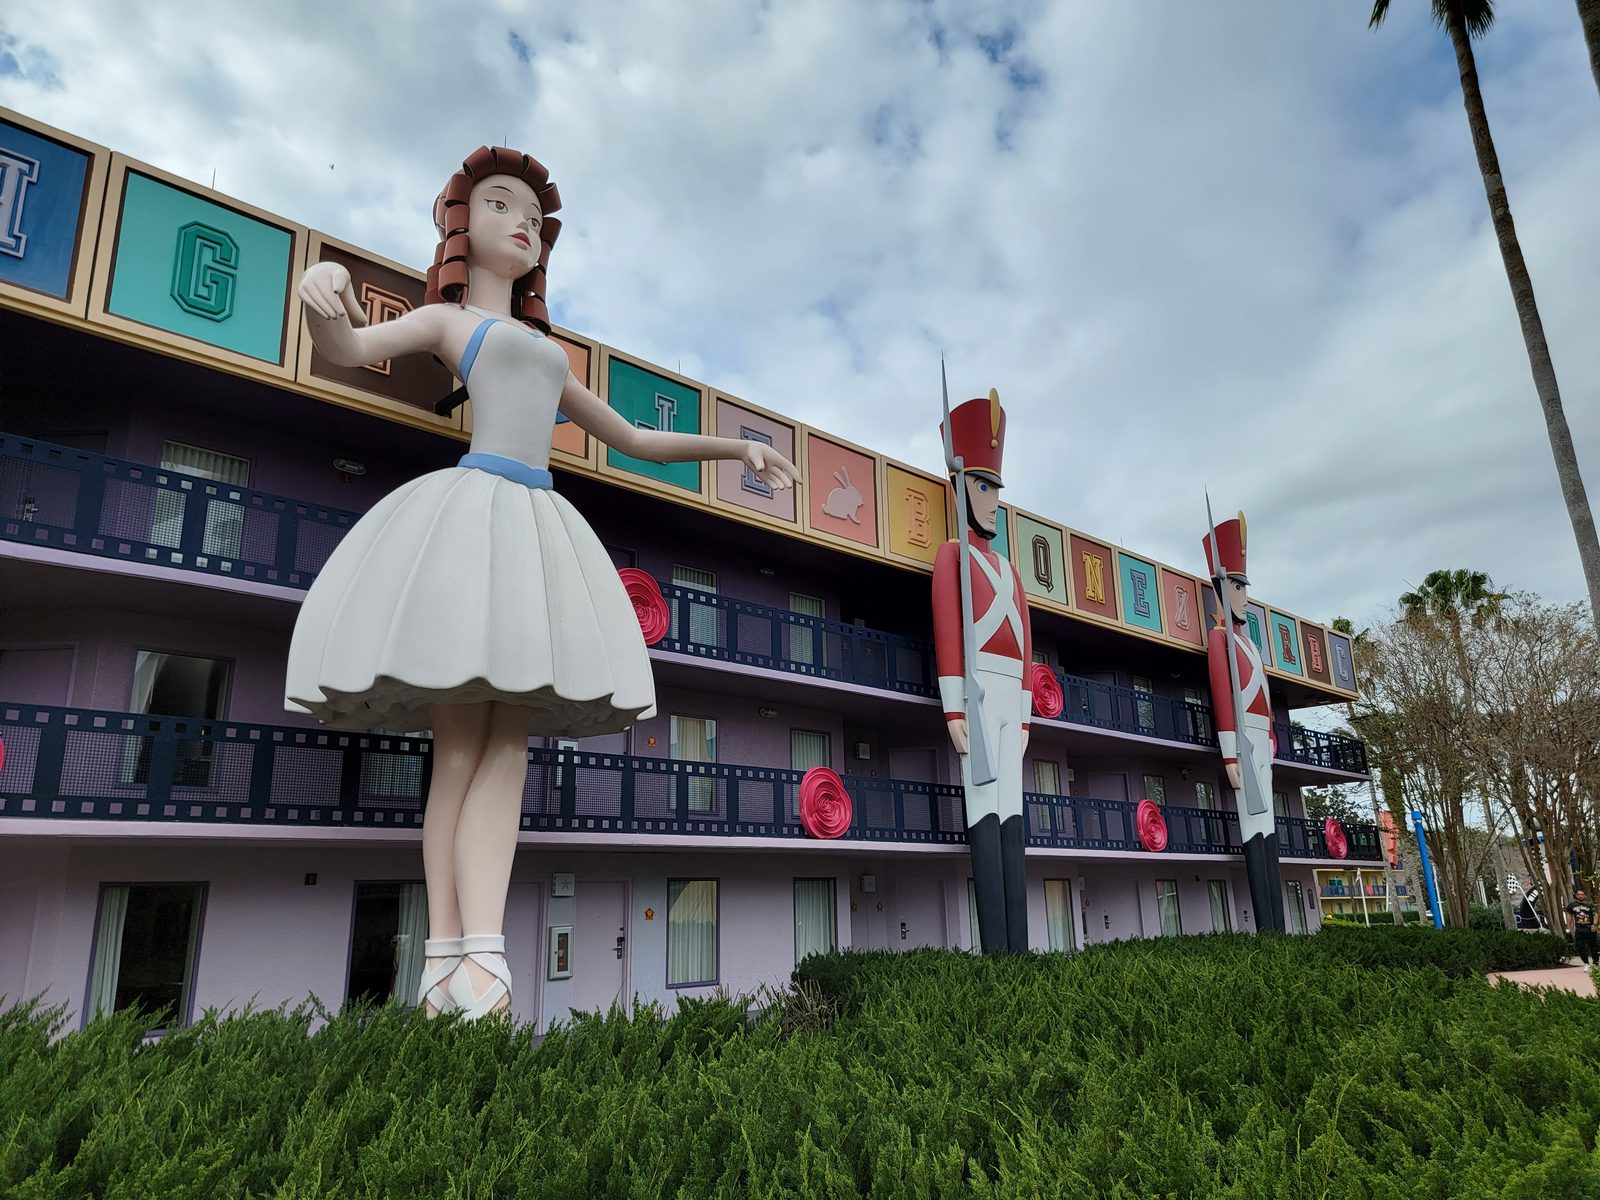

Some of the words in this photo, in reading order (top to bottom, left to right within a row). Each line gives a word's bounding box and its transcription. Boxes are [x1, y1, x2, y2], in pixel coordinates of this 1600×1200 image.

[170, 220, 240, 323] G
[905, 487, 932, 549] B
[1032, 534, 1055, 593] Q
[1082, 550, 1106, 605] N
[1130, 568, 1151, 619] E
[1277, 623, 1296, 665] R
[1307, 632, 1323, 673] B
